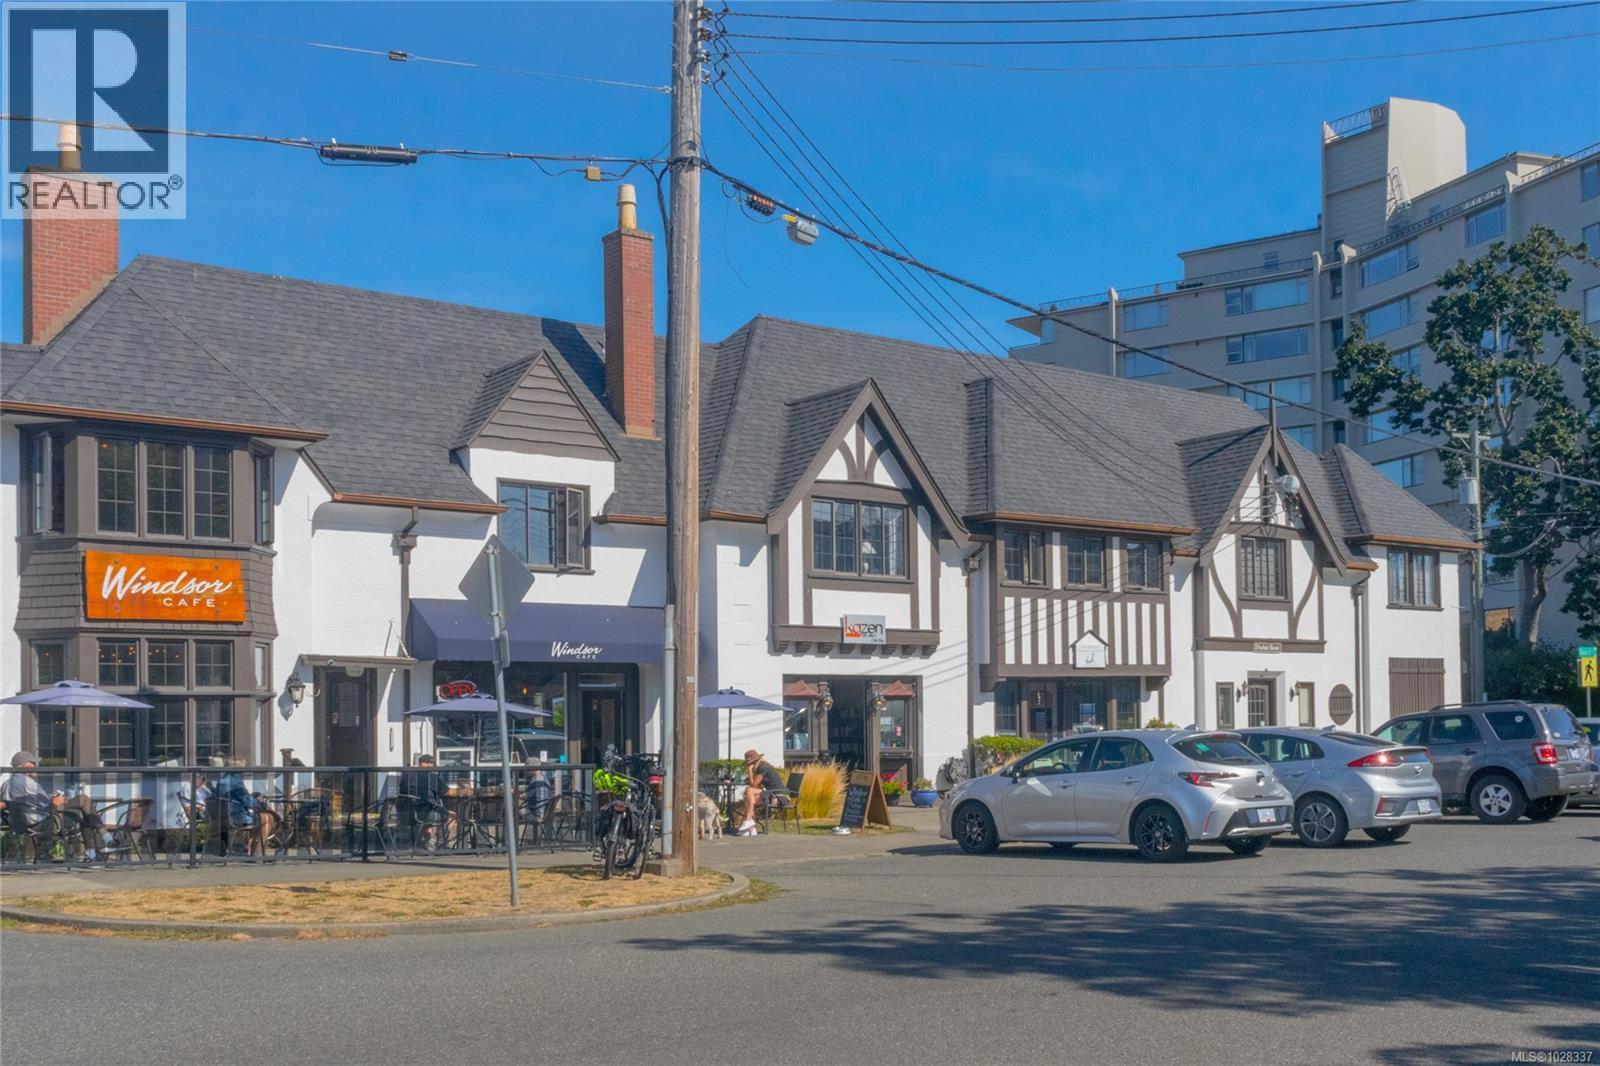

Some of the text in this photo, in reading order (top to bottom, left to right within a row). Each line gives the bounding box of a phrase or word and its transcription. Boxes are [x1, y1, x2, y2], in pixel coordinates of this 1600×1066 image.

[102, 564, 232, 601] Windsor
[163, 597, 216, 608] CAFE
[551, 641, 603, 658] Windsor
